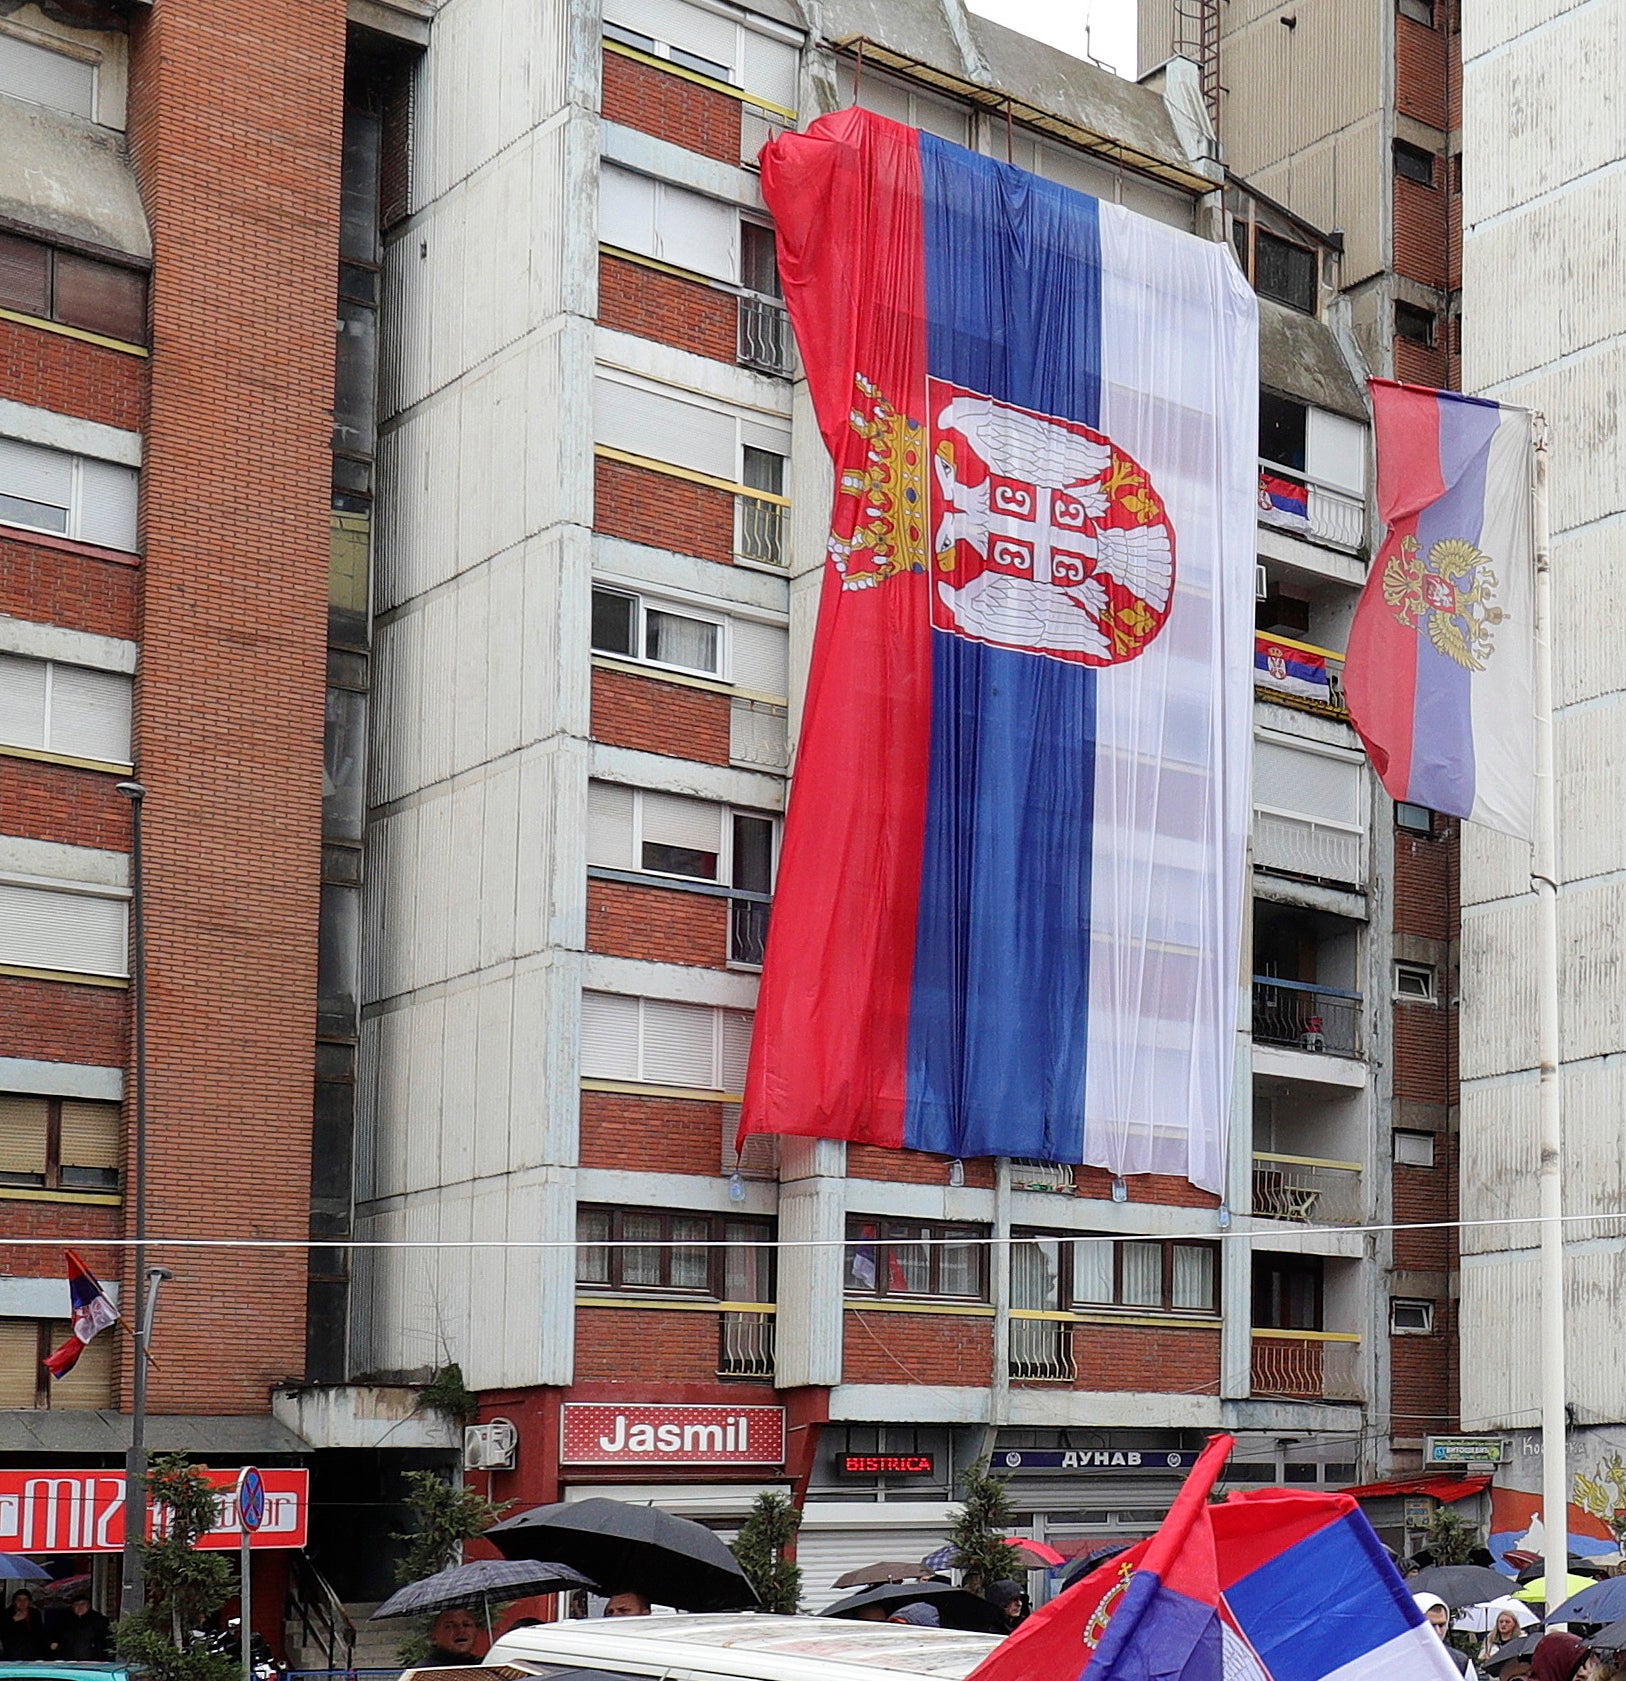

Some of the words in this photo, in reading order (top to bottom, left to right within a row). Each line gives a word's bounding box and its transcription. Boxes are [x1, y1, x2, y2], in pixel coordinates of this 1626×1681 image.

[600, 1415, 747, 1452] Jasmil
[846, 1457, 932, 1472] BISTRICA
[1062, 1451, 1142, 1467] ДУНАВ
